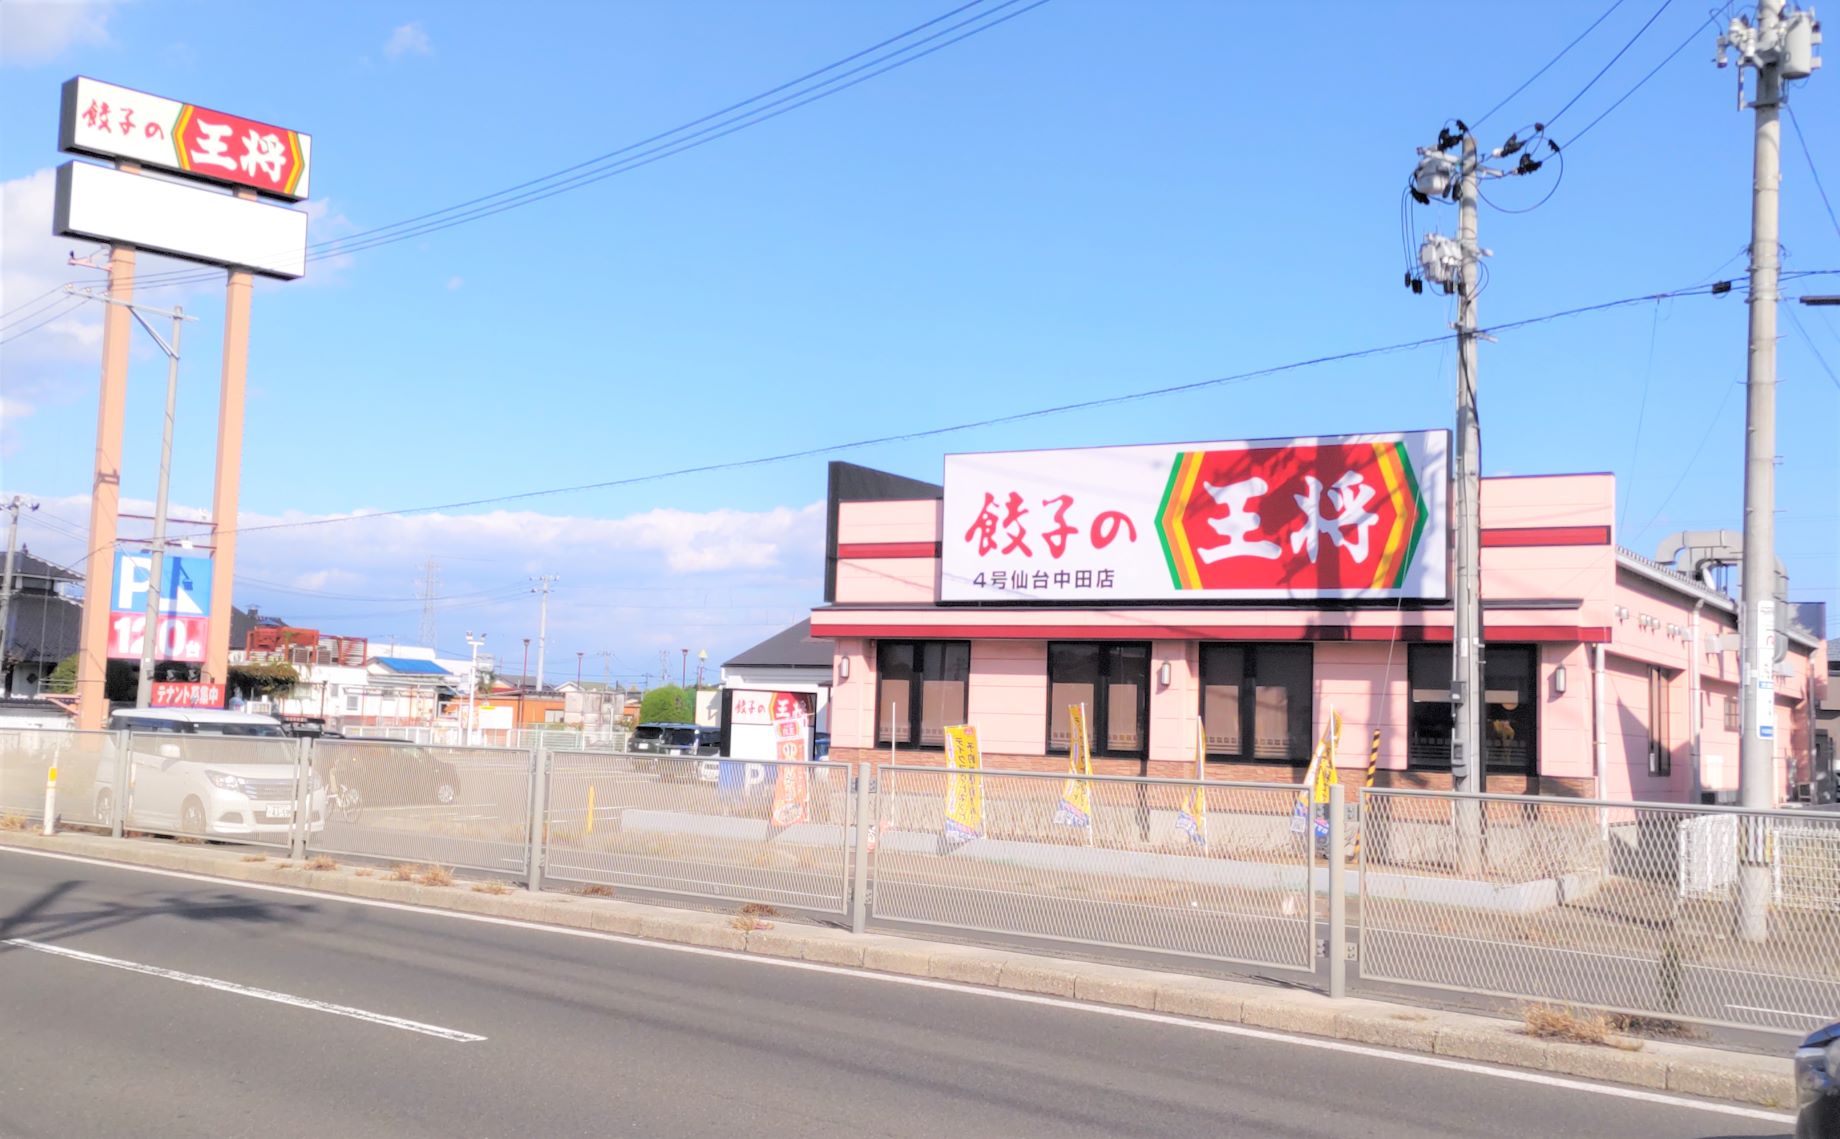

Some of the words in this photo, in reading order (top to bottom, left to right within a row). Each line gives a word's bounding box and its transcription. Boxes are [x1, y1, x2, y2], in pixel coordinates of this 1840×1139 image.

[82, 98, 287, 183] 餃子の王将
[964, 469, 1379, 565] 餃子の王将
[118, 555, 152, 609] P
[973, 568, 1115, 590] 4号仙台中田店
[157, 685, 219, 705] テナント募集中
